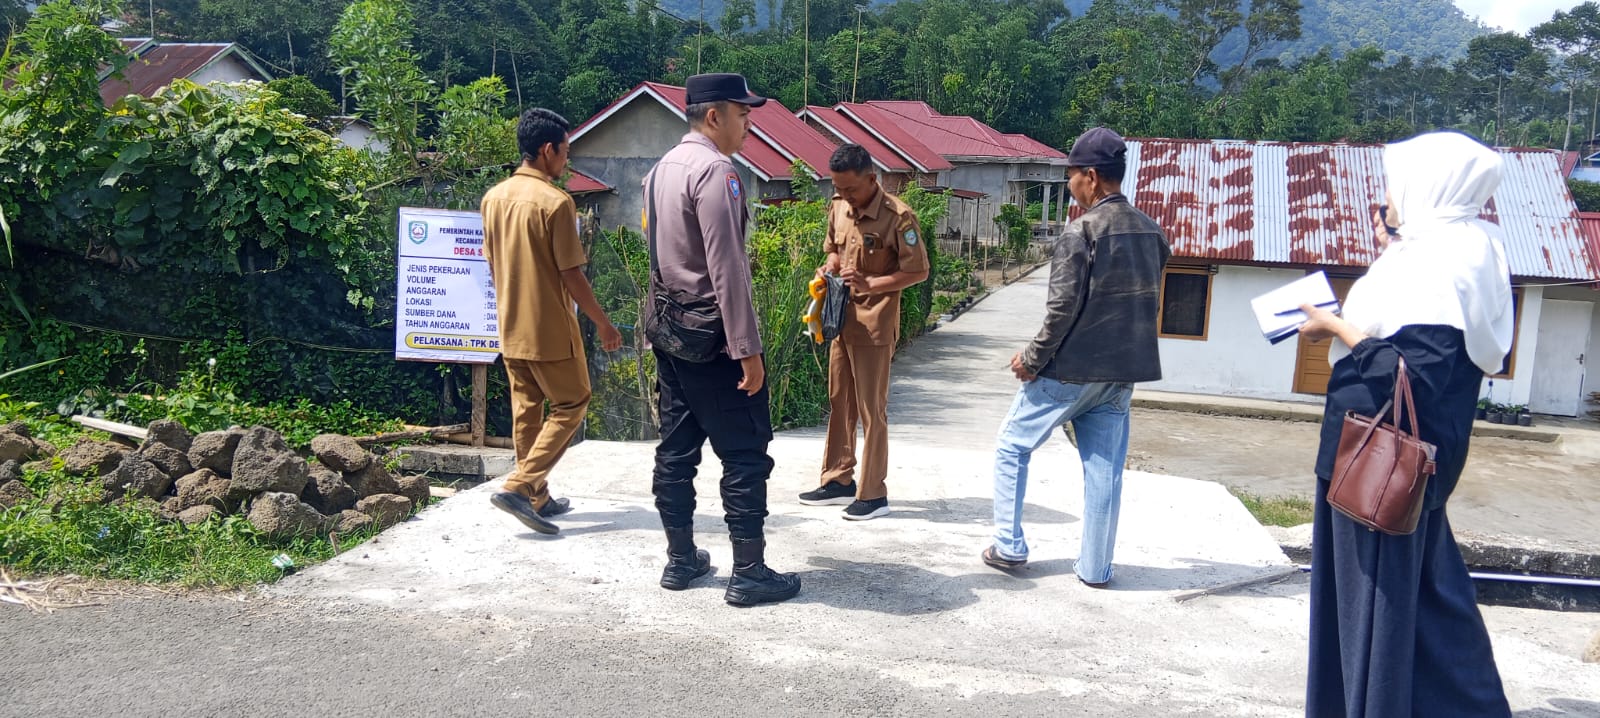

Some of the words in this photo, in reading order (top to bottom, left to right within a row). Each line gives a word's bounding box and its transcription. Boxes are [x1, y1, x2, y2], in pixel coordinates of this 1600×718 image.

[453, 247, 476, 256] DESA
[406, 264, 427, 273] JENIS
[428, 265, 471, 275] PEKERJAAN
[406, 275, 437, 285] VOLUME
[406, 287, 447, 296] ANGGARAN
[405, 297, 432, 306] LOKASI
[405, 308, 435, 317] SUMBER
[436, 310, 457, 319] DANA
[405, 320, 429, 328] TAHUN
[429, 321, 470, 330] ANGGARAN
[413, 336, 464, 347] PELAKSANA
[470, 339, 487, 349] TPK
[488, 340, 500, 349] DE
